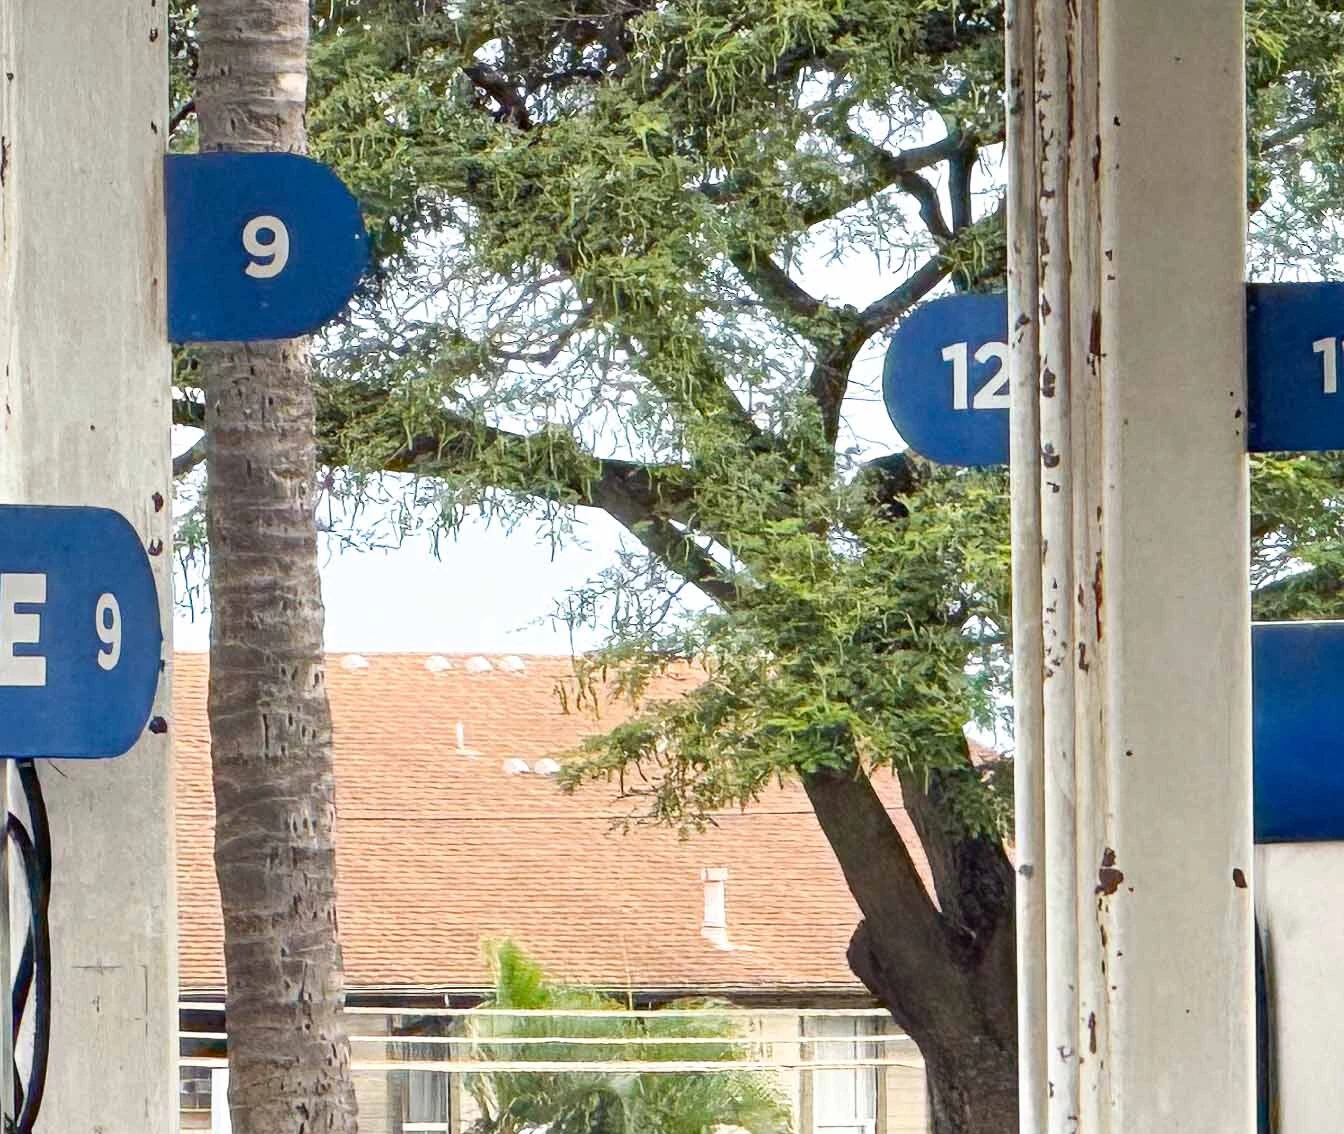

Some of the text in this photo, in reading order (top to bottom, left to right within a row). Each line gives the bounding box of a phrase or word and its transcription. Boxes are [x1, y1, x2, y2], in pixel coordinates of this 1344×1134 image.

[242, 215, 290, 279] 9
[942, 341, 1010, 410] 12
[94, 591, 123, 672] 9
